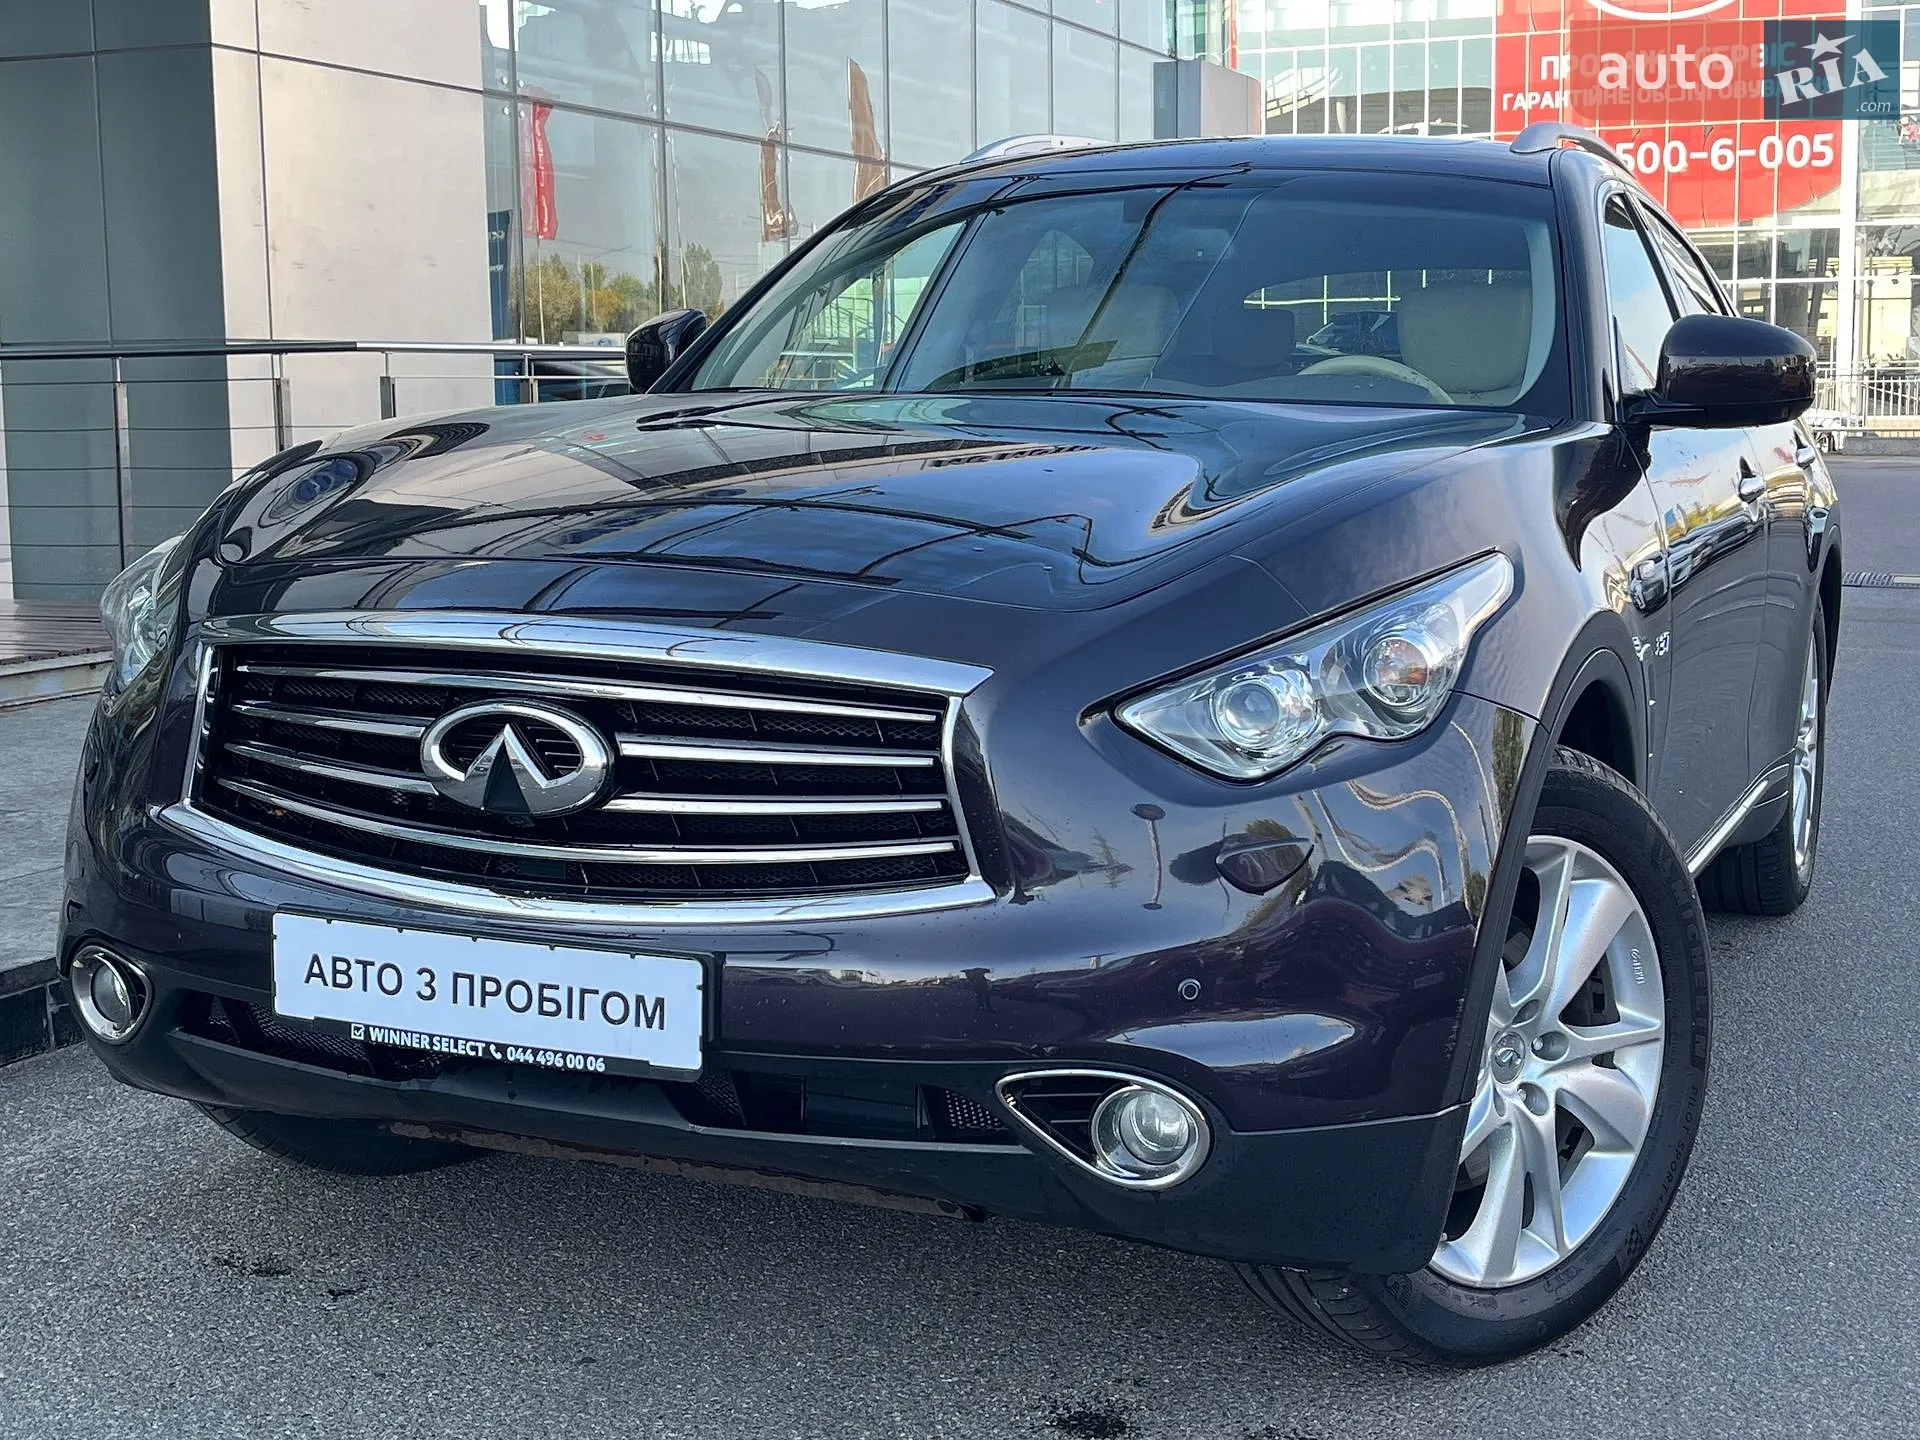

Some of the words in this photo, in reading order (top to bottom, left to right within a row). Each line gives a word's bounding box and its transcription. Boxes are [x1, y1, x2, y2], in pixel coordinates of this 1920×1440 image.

[1541, 48, 1667, 80] ПРОАЖ
[304, 953, 403, 996] АВТО
[452, 972, 666, 1031] ПРОБІГОМ
[369, 1026, 430, 1050] WINNER
[432, 1035, 486, 1057] SELECT
[507, 1046, 534, 1063] 044
[536, 1050, 564, 1068] 496
[566, 1054, 584, 1070] 00
[586, 1055, 606, 1072] 06
